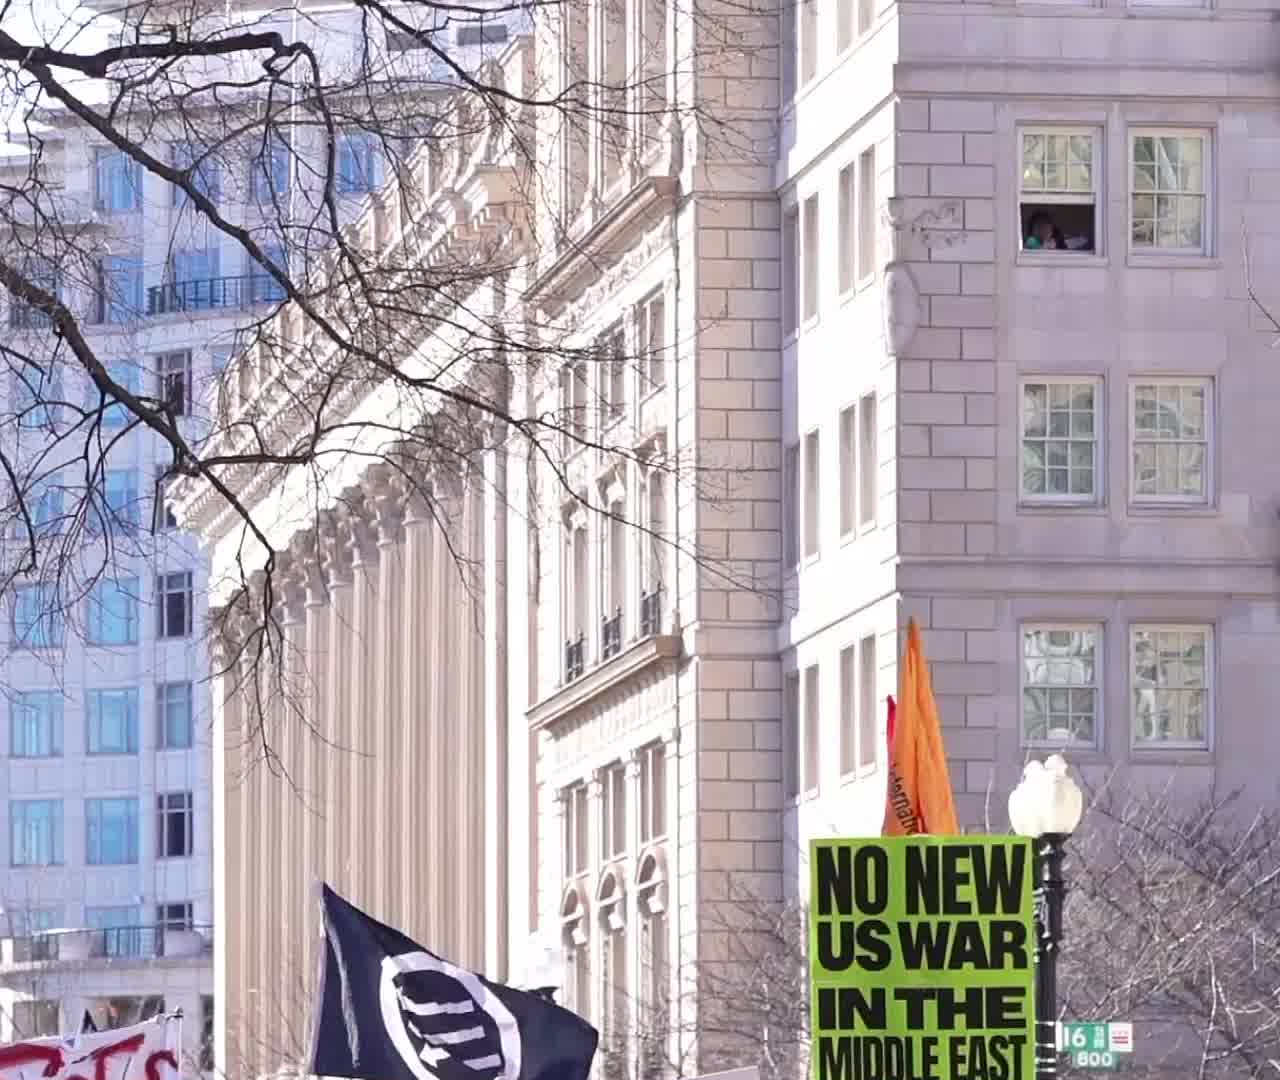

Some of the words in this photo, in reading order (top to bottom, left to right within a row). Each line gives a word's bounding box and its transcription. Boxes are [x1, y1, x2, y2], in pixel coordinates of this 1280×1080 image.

[817, 845, 888, 915] NO
[904, 844, 1026, 915] NEW
[817, 919, 892, 971] US
[897, 920, 1028, 970] WAR
[818, 987, 886, 1030] IN
[894, 987, 1027, 1030] THE
[1064, 1026, 1086, 1047] 16
